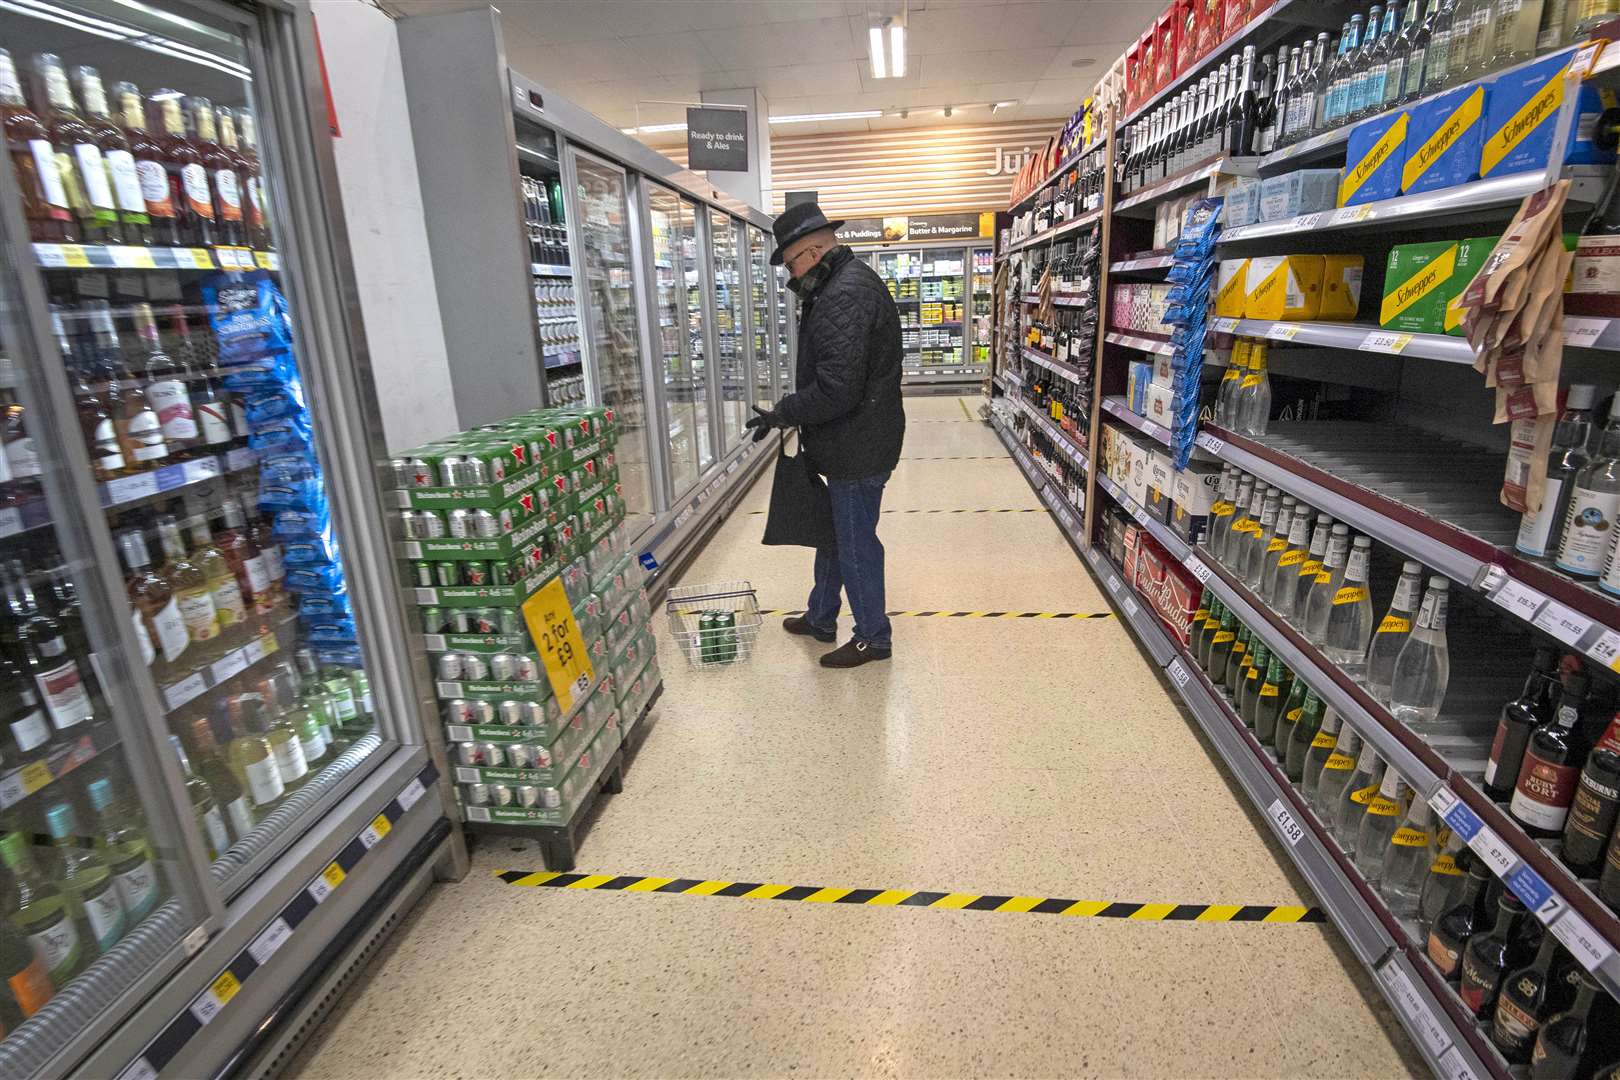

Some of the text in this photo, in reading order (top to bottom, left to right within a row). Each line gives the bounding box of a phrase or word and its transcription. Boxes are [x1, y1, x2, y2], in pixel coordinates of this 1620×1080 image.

[1502, 90, 1556, 149] Schweppes
[691, 131, 744, 142] Ready to drink
[1418, 118, 1460, 168] Schweppes
[706, 142, 712, 150] &
[1355, 140, 1390, 183] Schweppes
[851, 230, 882, 239] Puddings
[938, 225, 972, 235] Margarine
[1392, 250, 1399, 262] 12
[1460, 245, 1470, 258] 12
[1254, 277, 1278, 302] Schweppes
[1396, 270, 1437, 307] Schweppes
[542, 618, 570, 652] 2 for
[558, 641, 574, 667] £9
[1595, 642, 1616, 657] £14
[1525, 780, 1559, 798] PORT
[1530, 775, 1556, 789] RUBY
[1277, 811, 1301, 841] £1.58
